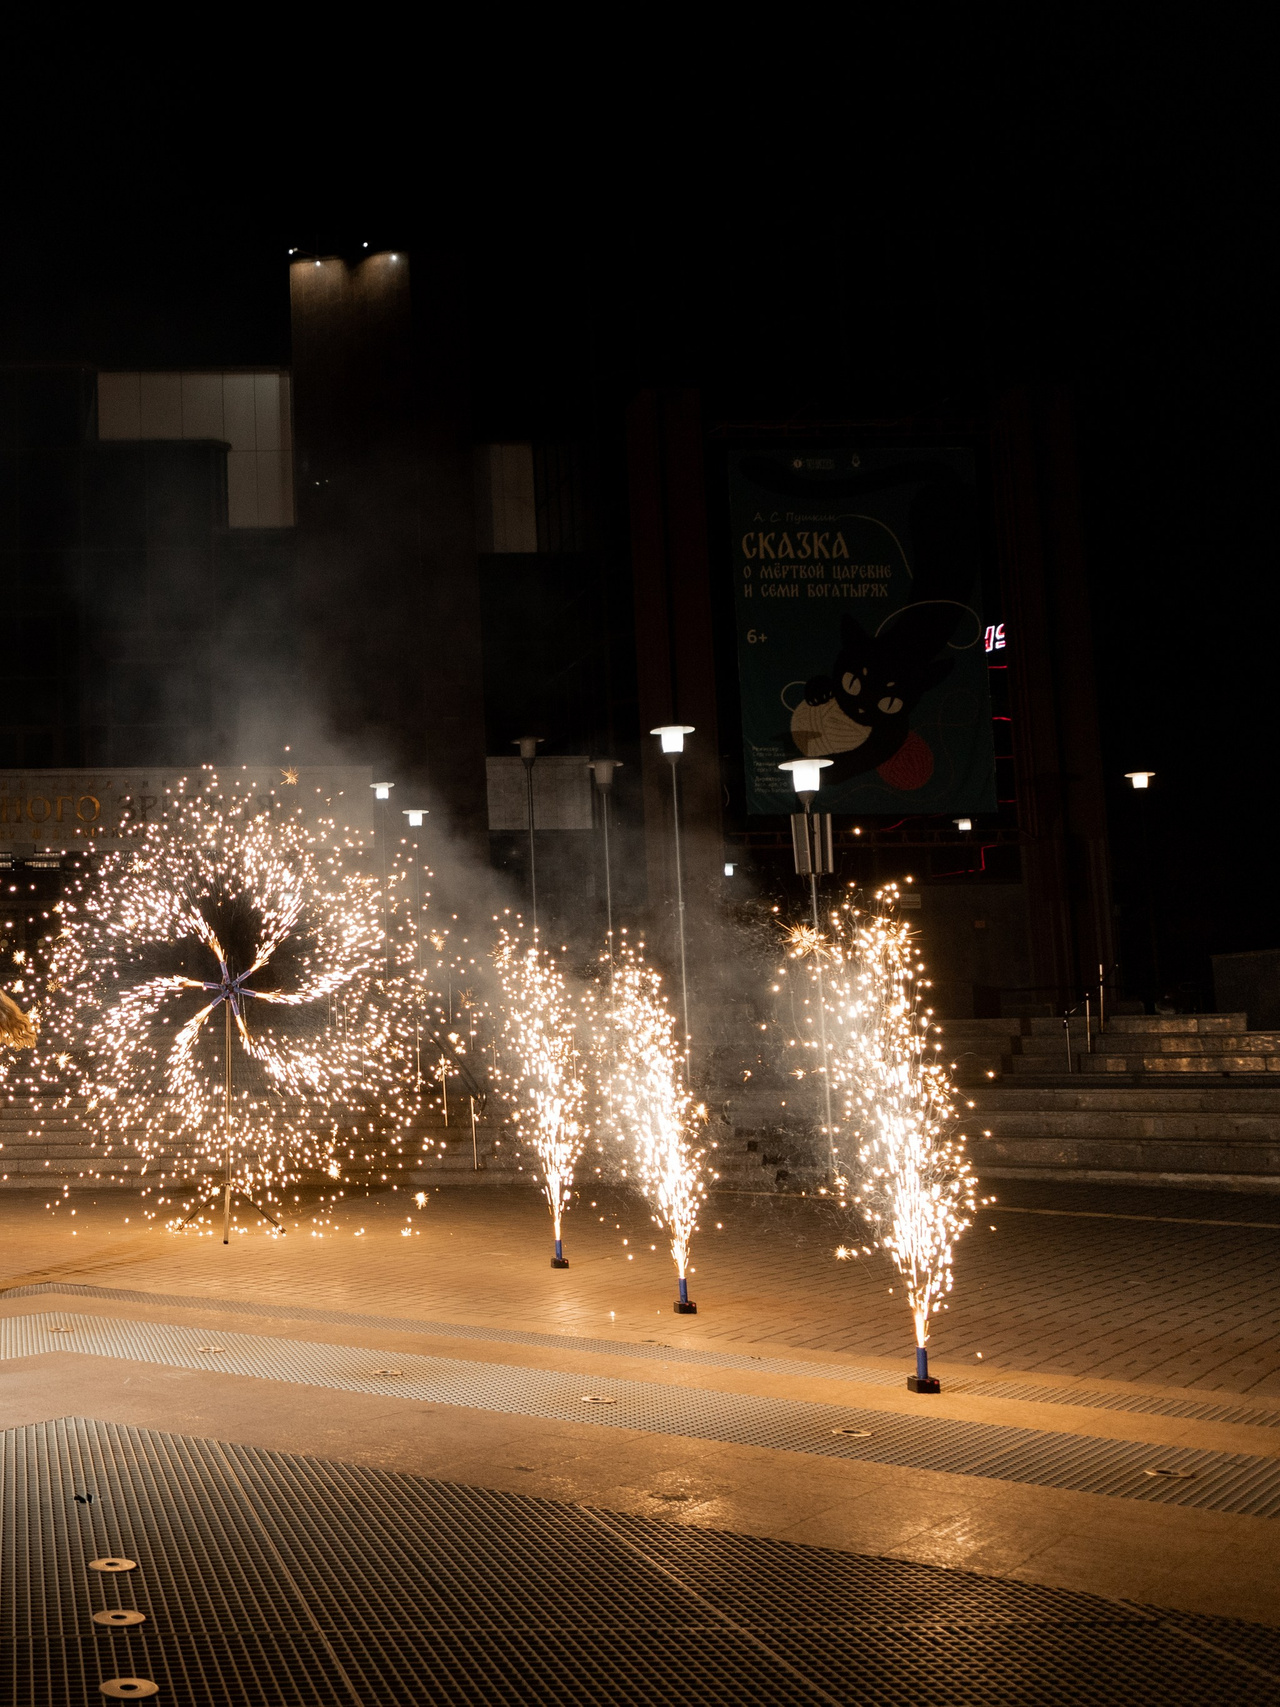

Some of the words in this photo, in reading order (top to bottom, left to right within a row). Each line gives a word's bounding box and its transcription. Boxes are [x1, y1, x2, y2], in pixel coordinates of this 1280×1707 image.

[785, 511, 838, 525] Пушкин
[741, 531, 850, 560] СКАЗКА
[743, 565, 752, 579] О
[760, 563, 824, 579] МЁРТВОЙ
[832, 565, 892, 581] ЦАРЕВНЕ
[744, 583, 753, 598] И
[760, 583, 800, 598] СЕМИ
[807, 583, 888, 598] БОГАТЫРЯХ
[746, 628, 768, 644] 6+
